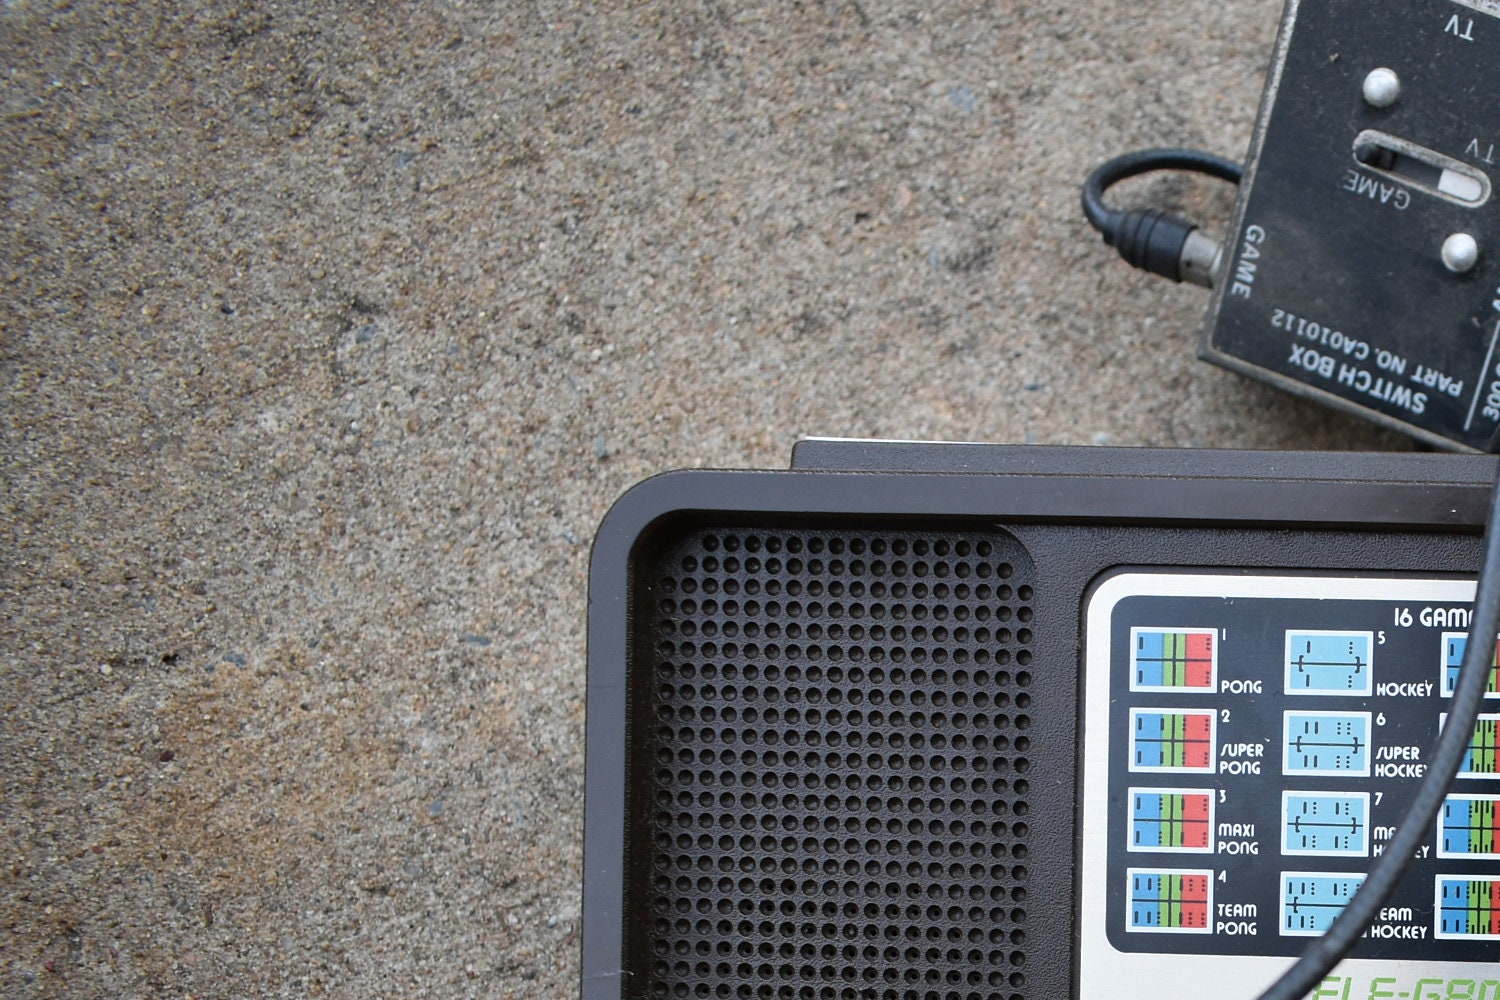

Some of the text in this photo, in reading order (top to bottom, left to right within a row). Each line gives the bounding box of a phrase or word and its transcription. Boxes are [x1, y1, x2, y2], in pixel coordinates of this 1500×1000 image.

[1444, 14, 1474, 41] TV
[1465, 138, 1495, 164] TV
[1343, 169, 1411, 210] GAME
[1231, 223, 1266, 299] GAME
[1270, 308, 1464, 398] PART NO. CA010112
[1288, 343, 1428, 414] SWITCH BOX
[1395, 607, 1473, 628] 16 GAM
[1222, 628, 1226, 641] 1
[1377, 631, 1385, 644] 5
[1221, 680, 1262, 694] PONG
[1377, 681, 1433, 697] HOCKEY
[1220, 709, 1230, 722] 2
[1375, 713, 1386, 726] 6
[1220, 743, 1264, 757] SUPER
[1376, 746, 1419, 760] SUPER
[1220, 761, 1260, 774] PONG
[1375, 763, 1427, 777] HOCKE
[1219, 790, 1226, 803] 3
[1374, 792, 1383, 805] 7
[1219, 823, 1254, 837] MAXI
[1218, 841, 1258, 855] PONG
[1217, 870, 1226, 882] 4
[1218, 904, 1256, 917] TEAM
[1376, 908, 1412, 921] EAM
[1217, 922, 1256, 935] PONG
[1372, 925, 1427, 939] HOCKEY
